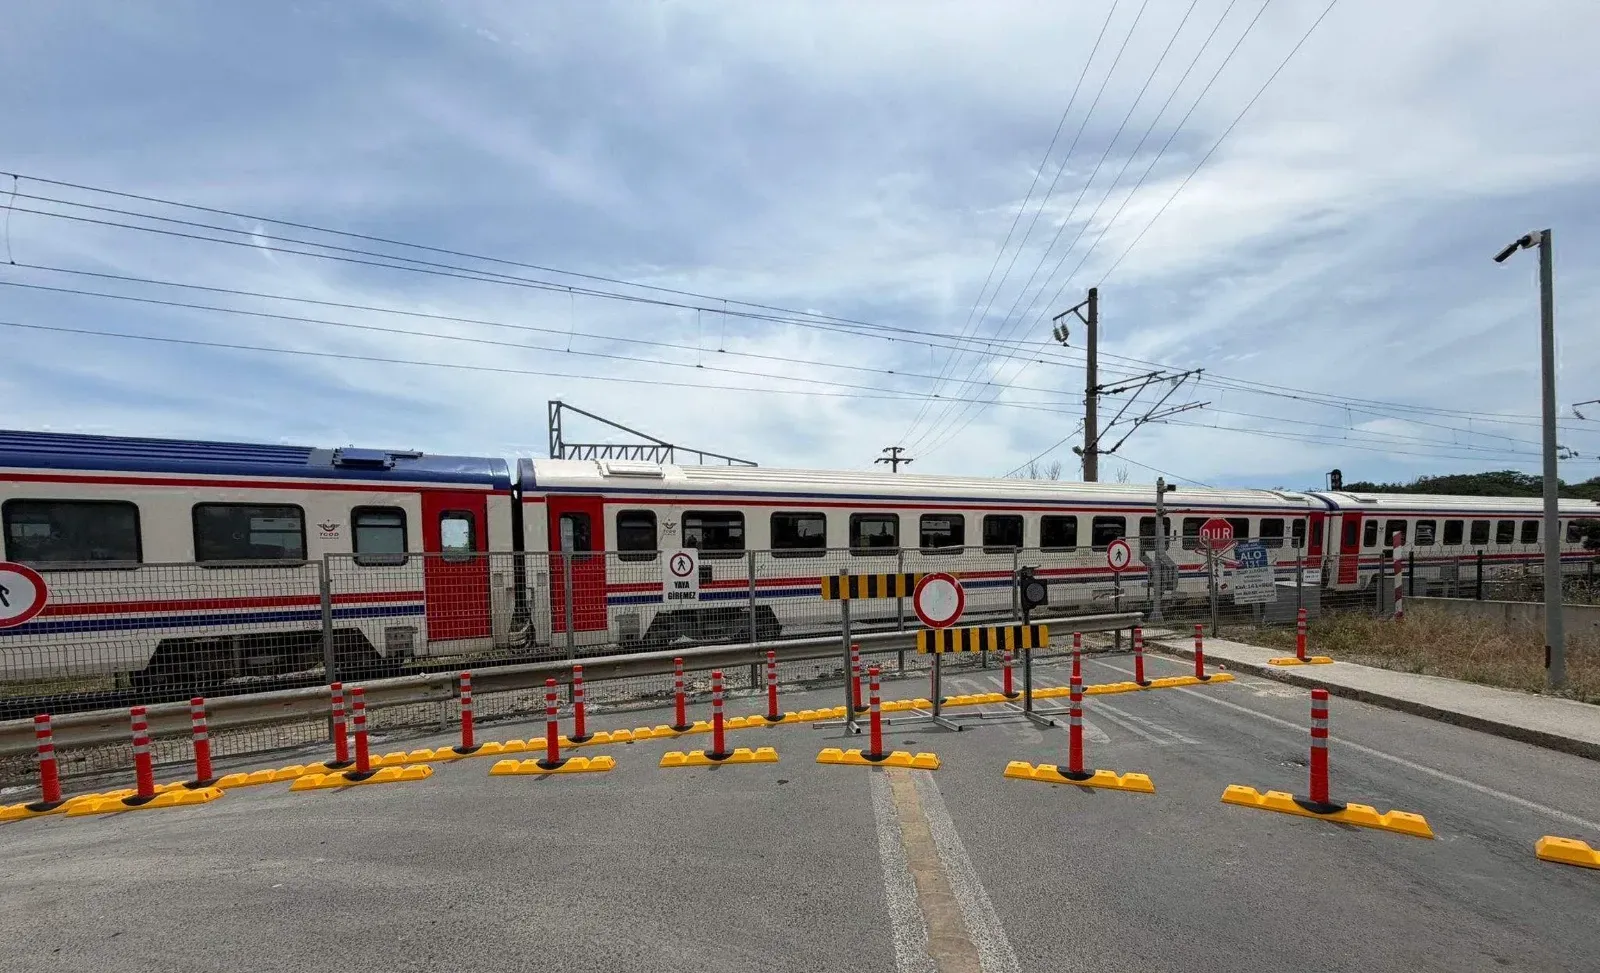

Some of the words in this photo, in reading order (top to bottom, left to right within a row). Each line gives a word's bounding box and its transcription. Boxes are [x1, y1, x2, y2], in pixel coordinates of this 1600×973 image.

[1202, 527, 1230, 541] DUR
[1240, 550, 1262, 561] ALO
[674, 581, 690, 589] YAYA
[667, 591, 696, 600] GİREMEZ
